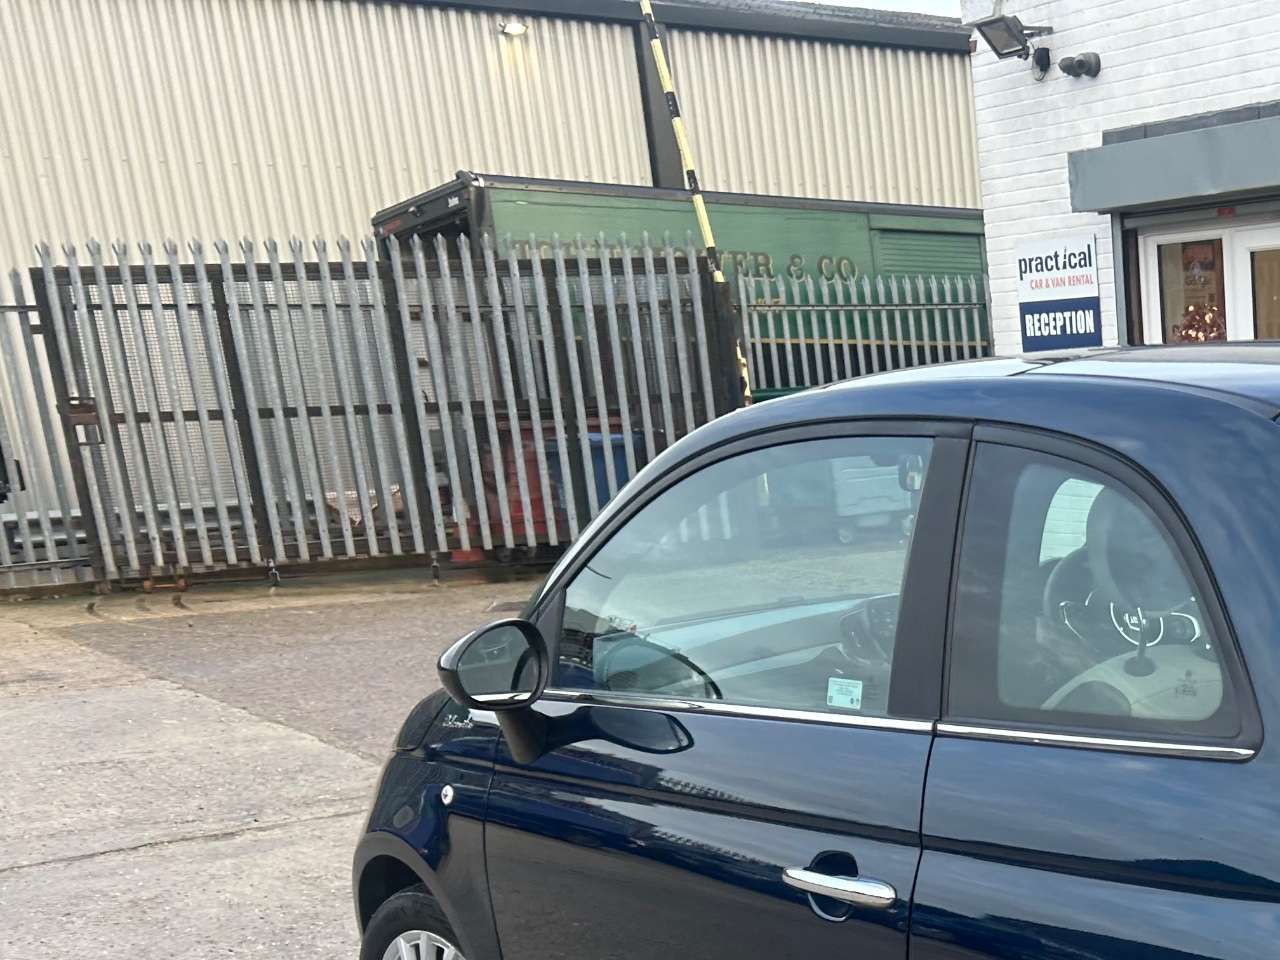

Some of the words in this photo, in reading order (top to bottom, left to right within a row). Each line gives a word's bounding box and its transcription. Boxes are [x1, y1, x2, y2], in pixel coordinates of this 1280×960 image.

[817, 255, 858, 285] CO
[1018, 244, 1092, 281] practical
[1030, 279, 1043, 290] CAR
[1050, 276, 1066, 288] VAN
[1067, 274, 1094, 287] RENTAL
[1024, 309, 1095, 337] RECEPTION
